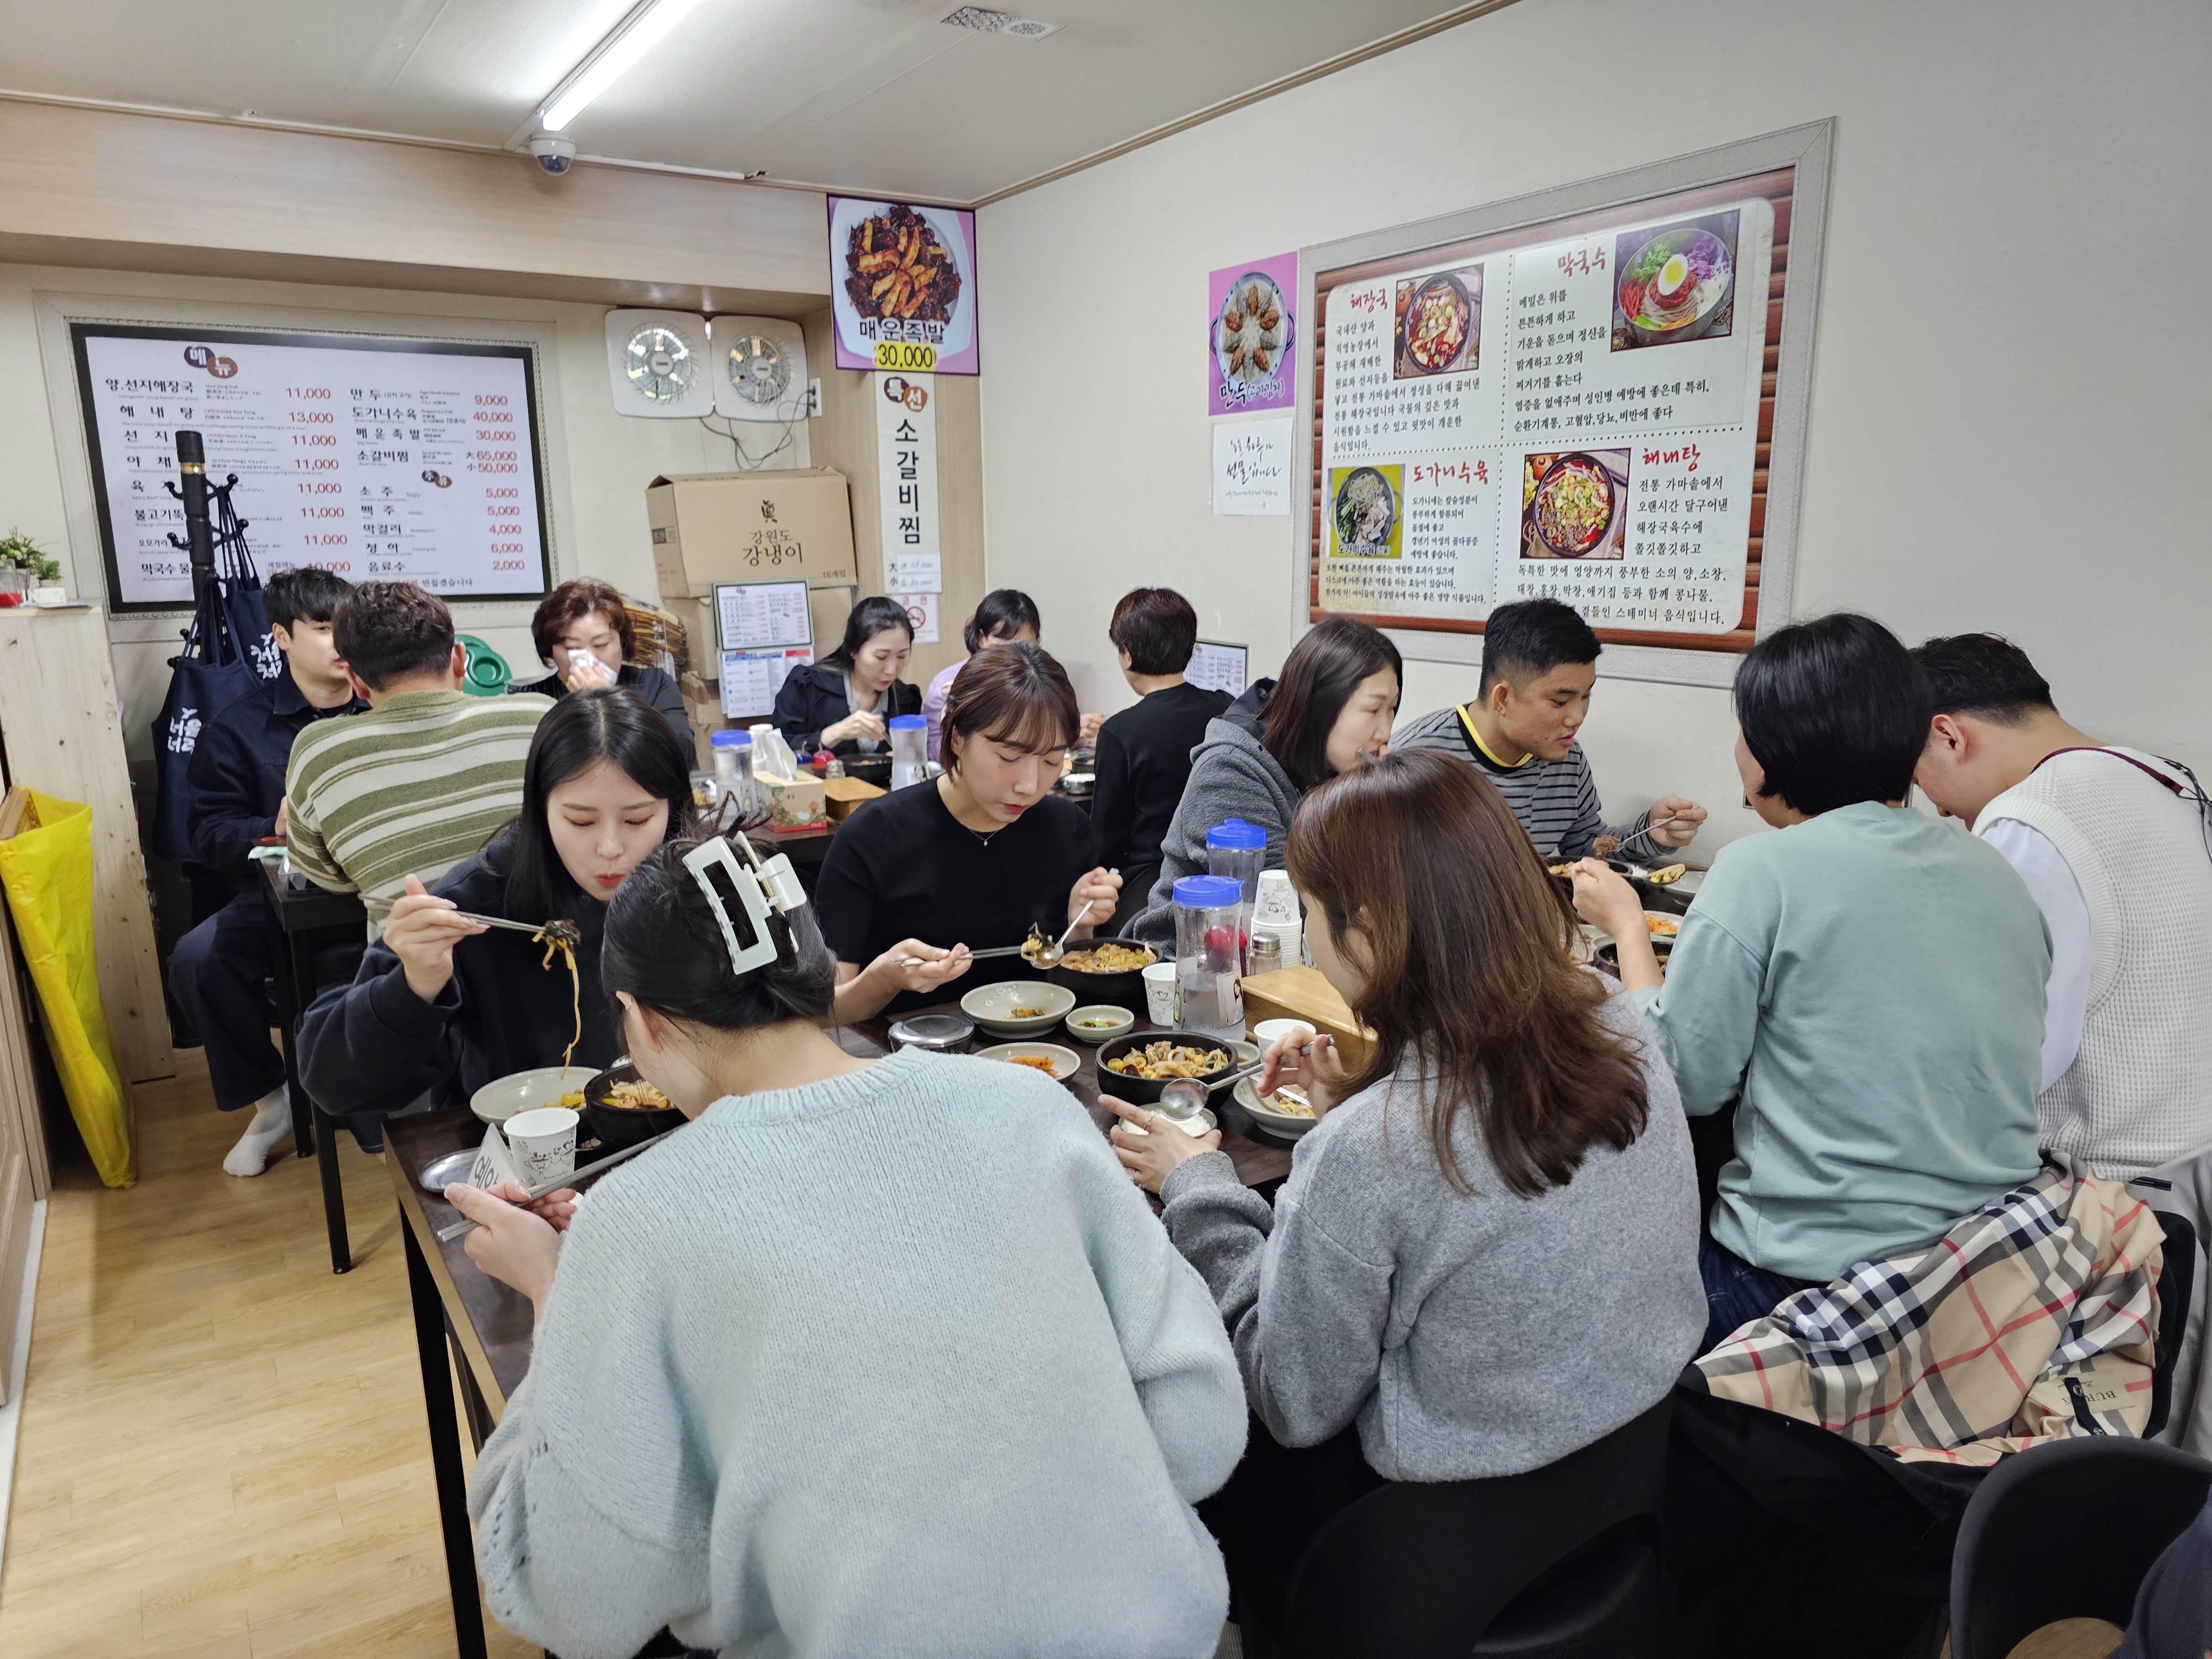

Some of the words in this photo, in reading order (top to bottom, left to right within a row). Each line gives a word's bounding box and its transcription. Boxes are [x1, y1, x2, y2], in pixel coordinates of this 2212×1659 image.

[1557, 246, 1606, 278] 막국수
[1350, 288, 1387, 314] 해장국
[1519, 293, 1546, 308] 메밀은
[1549, 289, 1567, 304] 위를
[1518, 312, 1553, 330] 튼튼하게
[1557, 310, 1575, 324] 하고
[860, 321, 945, 344] 매운족발
[1336, 322, 1357, 336] 국내산
[1517, 335, 1543, 350] 기운을
[1578, 326, 1607, 342] 정신을
[190, 347, 232, 376] 메뉴
[1516, 356, 1552, 372] 맑게하고
[1555, 351, 1583, 365] 오장의
[106, 378, 194, 394] 양.선지해장국
[286, 388, 331, 399] 11,000
[887, 379, 922, 410] 특선
[1352, 392, 1365, 403] 전통
[1410, 383, 1432, 397] 정성을
[1515, 398, 1541, 412] 염증을
[1545, 393, 1580, 409] 없애주며
[1584, 389, 1613, 405] 성인병
[1616, 386, 1646, 401] 예방에
[1650, 382, 1681, 398] 좋은데
[1684, 379, 1709, 394] 특히,
[474, 395, 508, 406] 9,000
[289, 411, 333, 424] 13,000
[352, 406, 418, 420] 도가니수육
[473, 411, 513, 423] 40,000
[1652, 405, 1673, 420] 좋다
[1383, 422, 1389, 434] 수
[1394, 421, 1407, 432] 있고
[1438, 415, 1462, 428] 개운한
[292, 435, 336, 447] 11,000
[476, 431, 515, 441] 30,000
[466, 451, 474, 460] 大
[477, 451, 517, 461] 65,000
[1642, 444, 1701, 472] 해내탕
[295, 459, 339, 471] 11,000
[478, 463, 518, 474] 50,000
[1413, 459, 1488, 487] 도가니수육
[298, 483, 342, 494] 11,000
[895, 419, 920, 544] 소갈비찜
[1639, 478, 1660, 492] 전통
[1666, 476, 1723, 492] 가마솥에서
[486, 488, 518, 499] 5,000
[1412, 496, 1443, 505] 도가니에는
[301, 507, 345, 519] 11,000
[487, 506, 520, 517] 5,000
[1685, 498, 1728, 513] 달구어낸
[489, 524, 521, 535] 4,000
[1636, 520, 1703, 534] 해장국육수에
[304, 534, 348, 546] 11,000
[750, 529, 792, 544] 강원도
[491, 544, 523, 554] 6,000
[742, 542, 802, 567] 강냉이
[1635, 542, 1702, 556] 쫄깃쫄깃하고
[492, 560, 525, 571] 2,000
[889, 562, 898, 572] 大
[1518, 564, 1546, 577] 독특한
[1550, 565, 1568, 577] 맛에
[1574, 565, 1613, 578] 영양까지
[1619, 566, 1651, 580] 풍부한
[1655, 566, 1676, 581] 소의
[890, 577, 898, 587] 小
[1623, 587, 1642, 600] 등과
[1648, 587, 1669, 601] 함께
[1663, 608, 1725, 624] 음식입니다.
